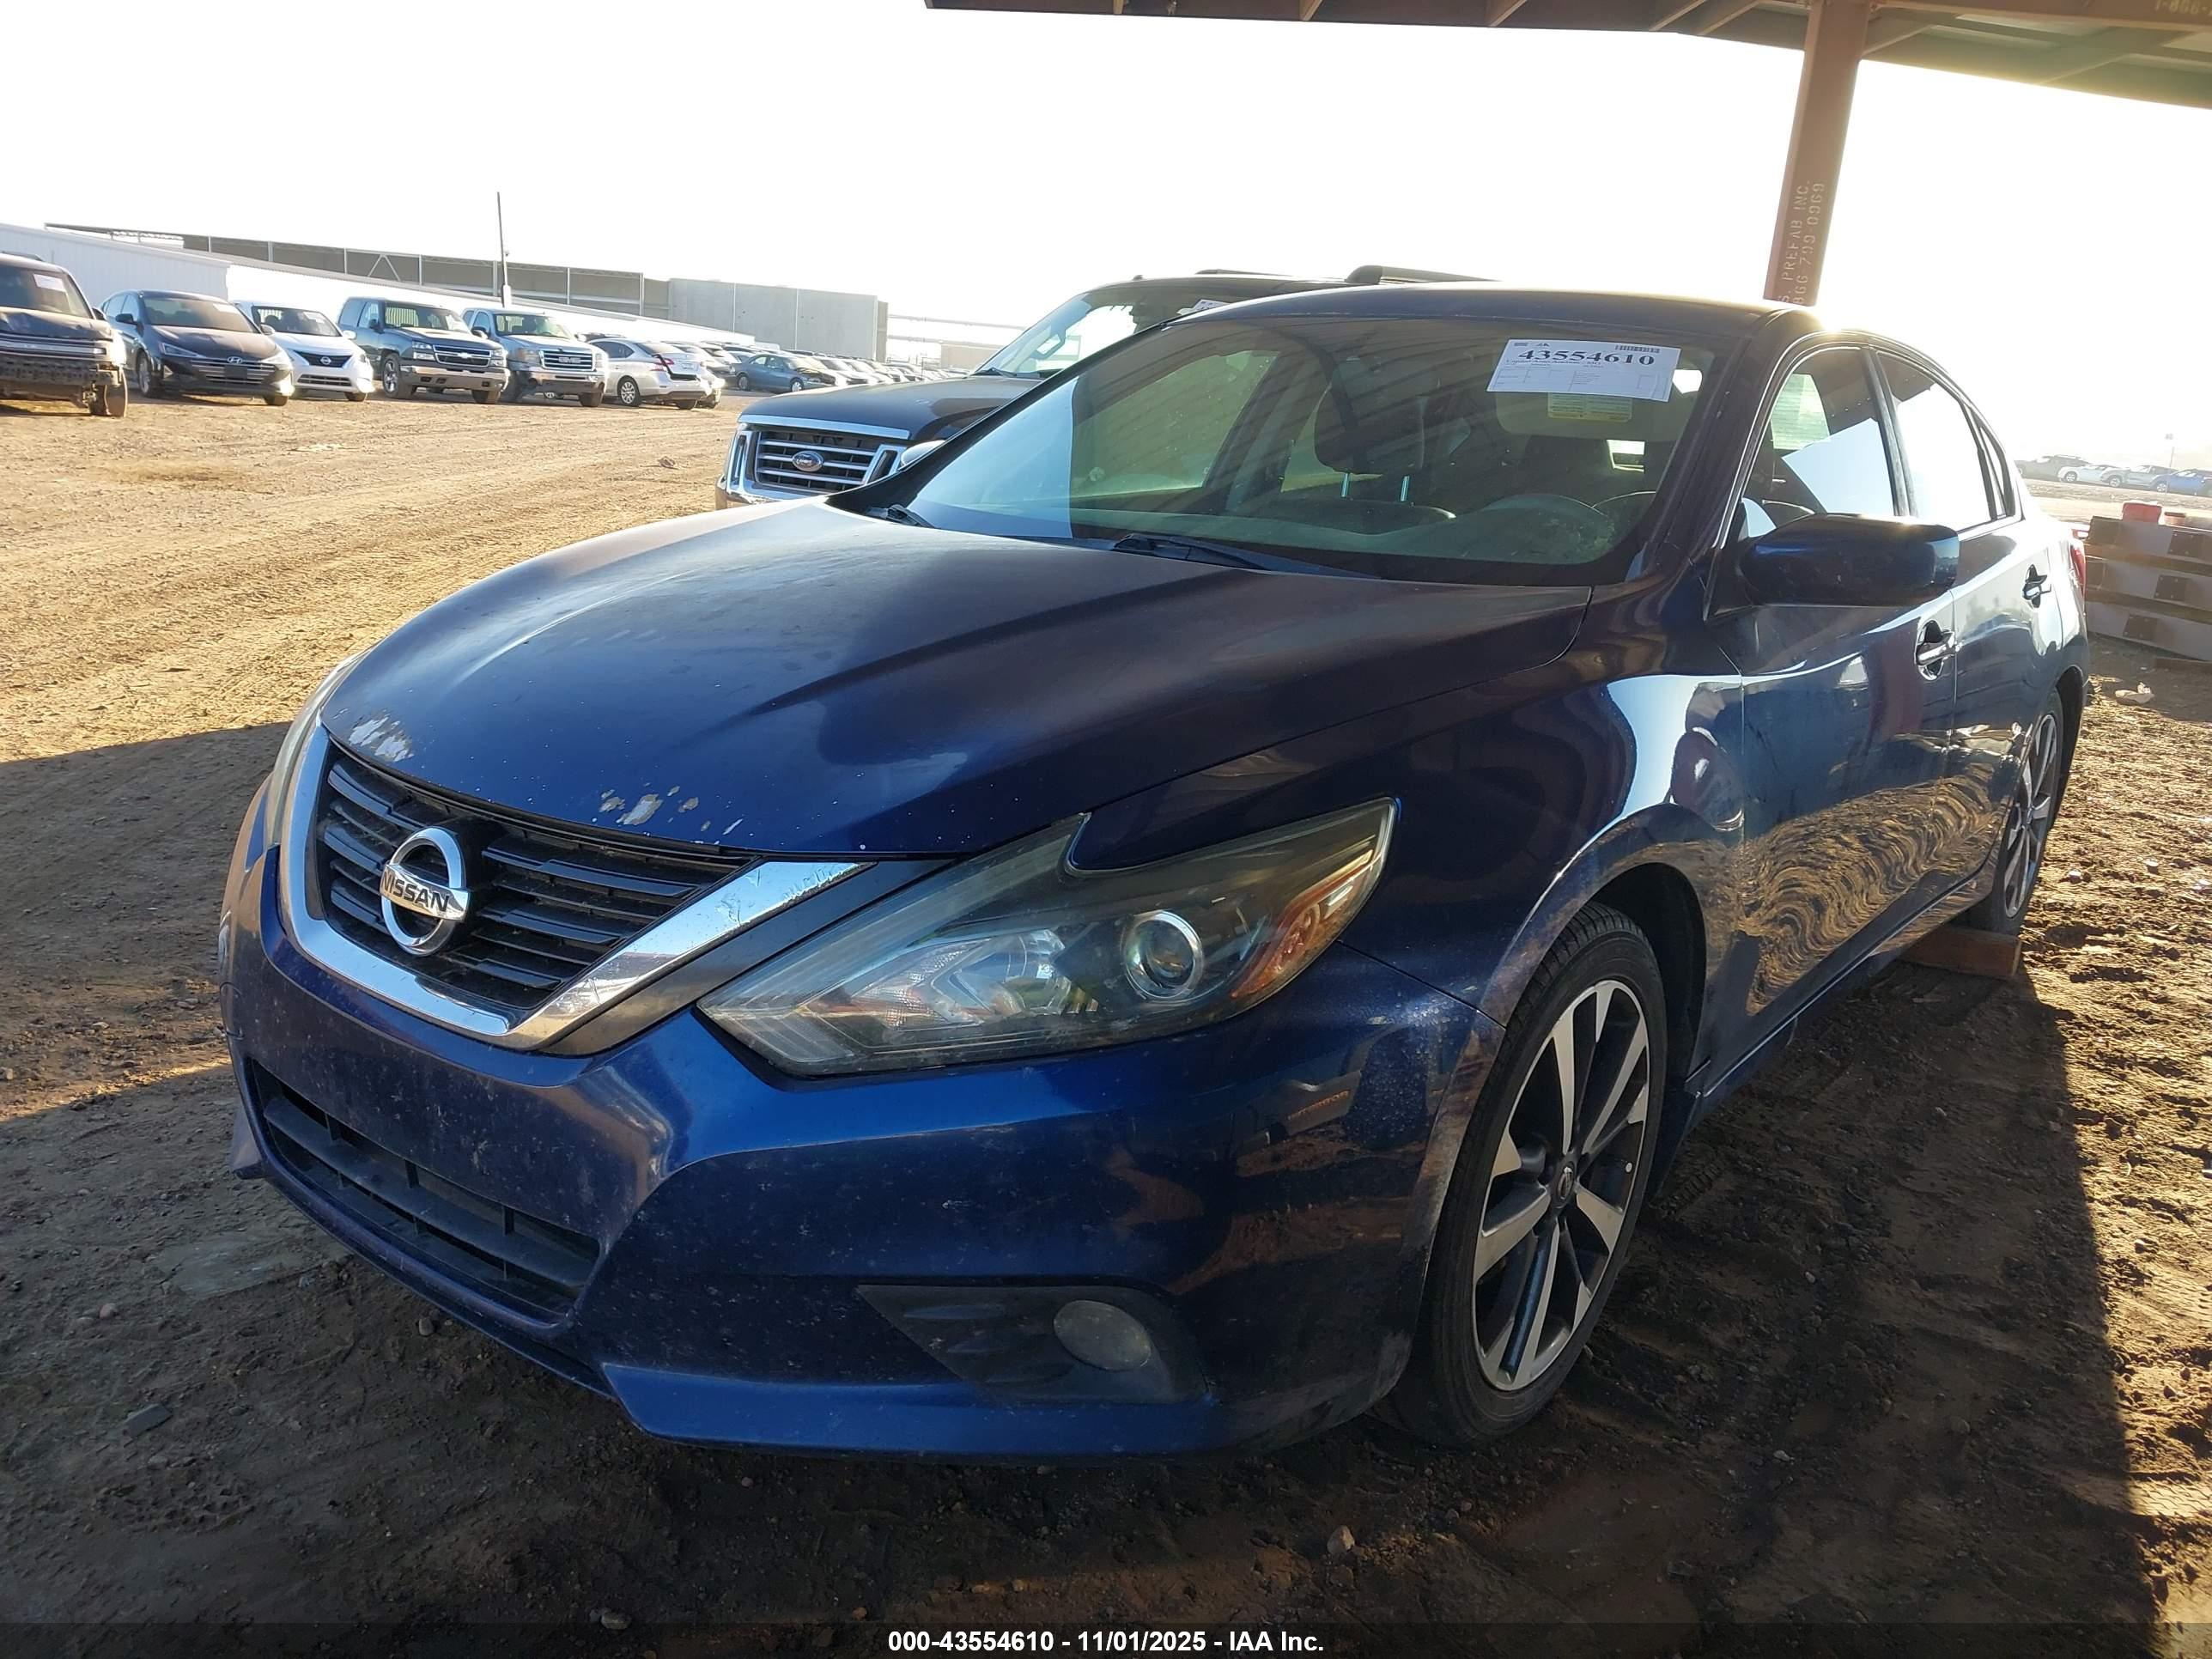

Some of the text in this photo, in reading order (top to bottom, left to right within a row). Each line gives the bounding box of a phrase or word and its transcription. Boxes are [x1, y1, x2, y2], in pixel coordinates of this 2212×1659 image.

[1782, 219, 1803, 281] PREFAB
[1793, 180, 1811, 210] INC.
[1518, 349, 1655, 366] 43554610
[381, 869, 450, 913] NISSAN
